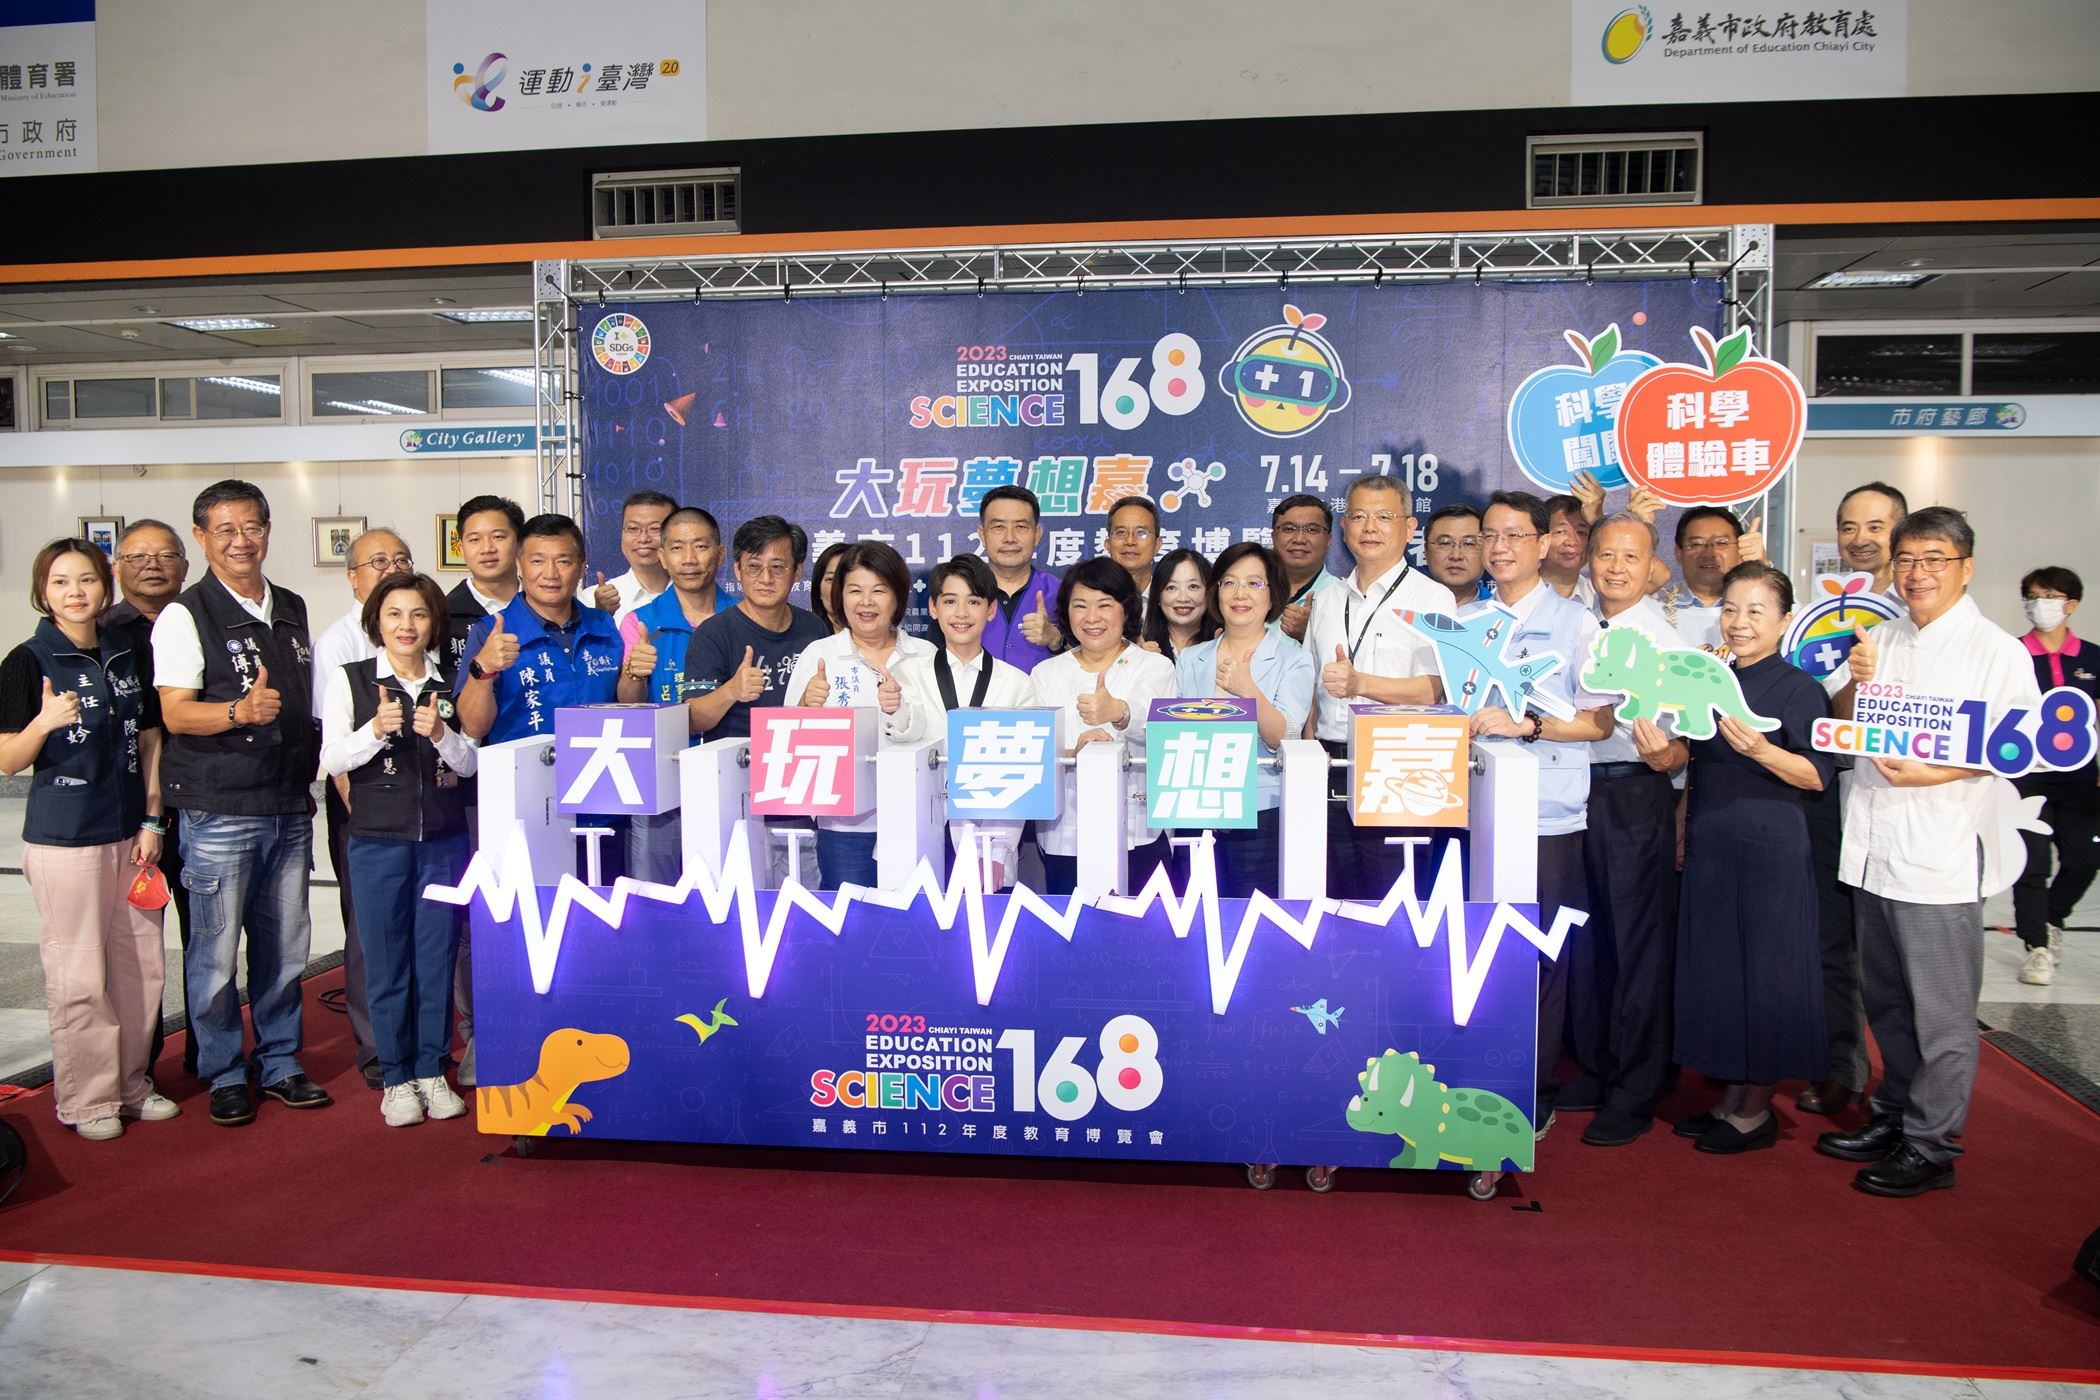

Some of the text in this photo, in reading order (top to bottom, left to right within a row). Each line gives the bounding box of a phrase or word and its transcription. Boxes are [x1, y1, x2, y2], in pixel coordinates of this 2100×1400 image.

[1661, 9, 1878, 45] 嘉義市政府教育處
[1664, 41, 1876, 58] Department of Education Chiayi City
[609, 343, 634, 352] SDGs
[957, 346, 1008, 362] 2023
[956, 362, 1063, 377] EDUCATION
[909, 393, 1065, 429] SCIENCE
[1065, 332, 1206, 431] 168
[956, 378, 1063, 393] EXPOSITION
[1667, 390, 1750, 430] 科學
[1889, 407, 1989, 426] 市府藝廊
[426, 430, 525, 448] City Gallery
[1646, 438, 1772, 480] 體驗車
[1260, 454, 1329, 493] 7.14
[537, 651, 556, 683] 議員
[78, 674, 100, 709] 主任
[518, 667, 545, 732] 陳家平
[1859, 682, 1903, 699] 2023
[1857, 698, 1954, 718] EDUCATION
[1814, 690, 2092, 775] SCIENCE 168
[1856, 712, 1952, 732] EXPOSITION
[560, 718, 653, 806] 大
[753, 718, 852, 806] 玩
[951, 720, 1051, 809] 夢
[1151, 731, 1254, 819] 想
[865, 1013, 993, 1036] 2023 CHIAYI TAIWAN
[865, 1034, 993, 1054] EDUCATION
[809, 1069, 996, 1113] SCIENCE
[995, 1013, 1164, 1122] 168
[865, 1053, 993, 1072] EXPOSITION
[812, 1117, 1165, 1146] 嘉義市112年度教育博覽會
